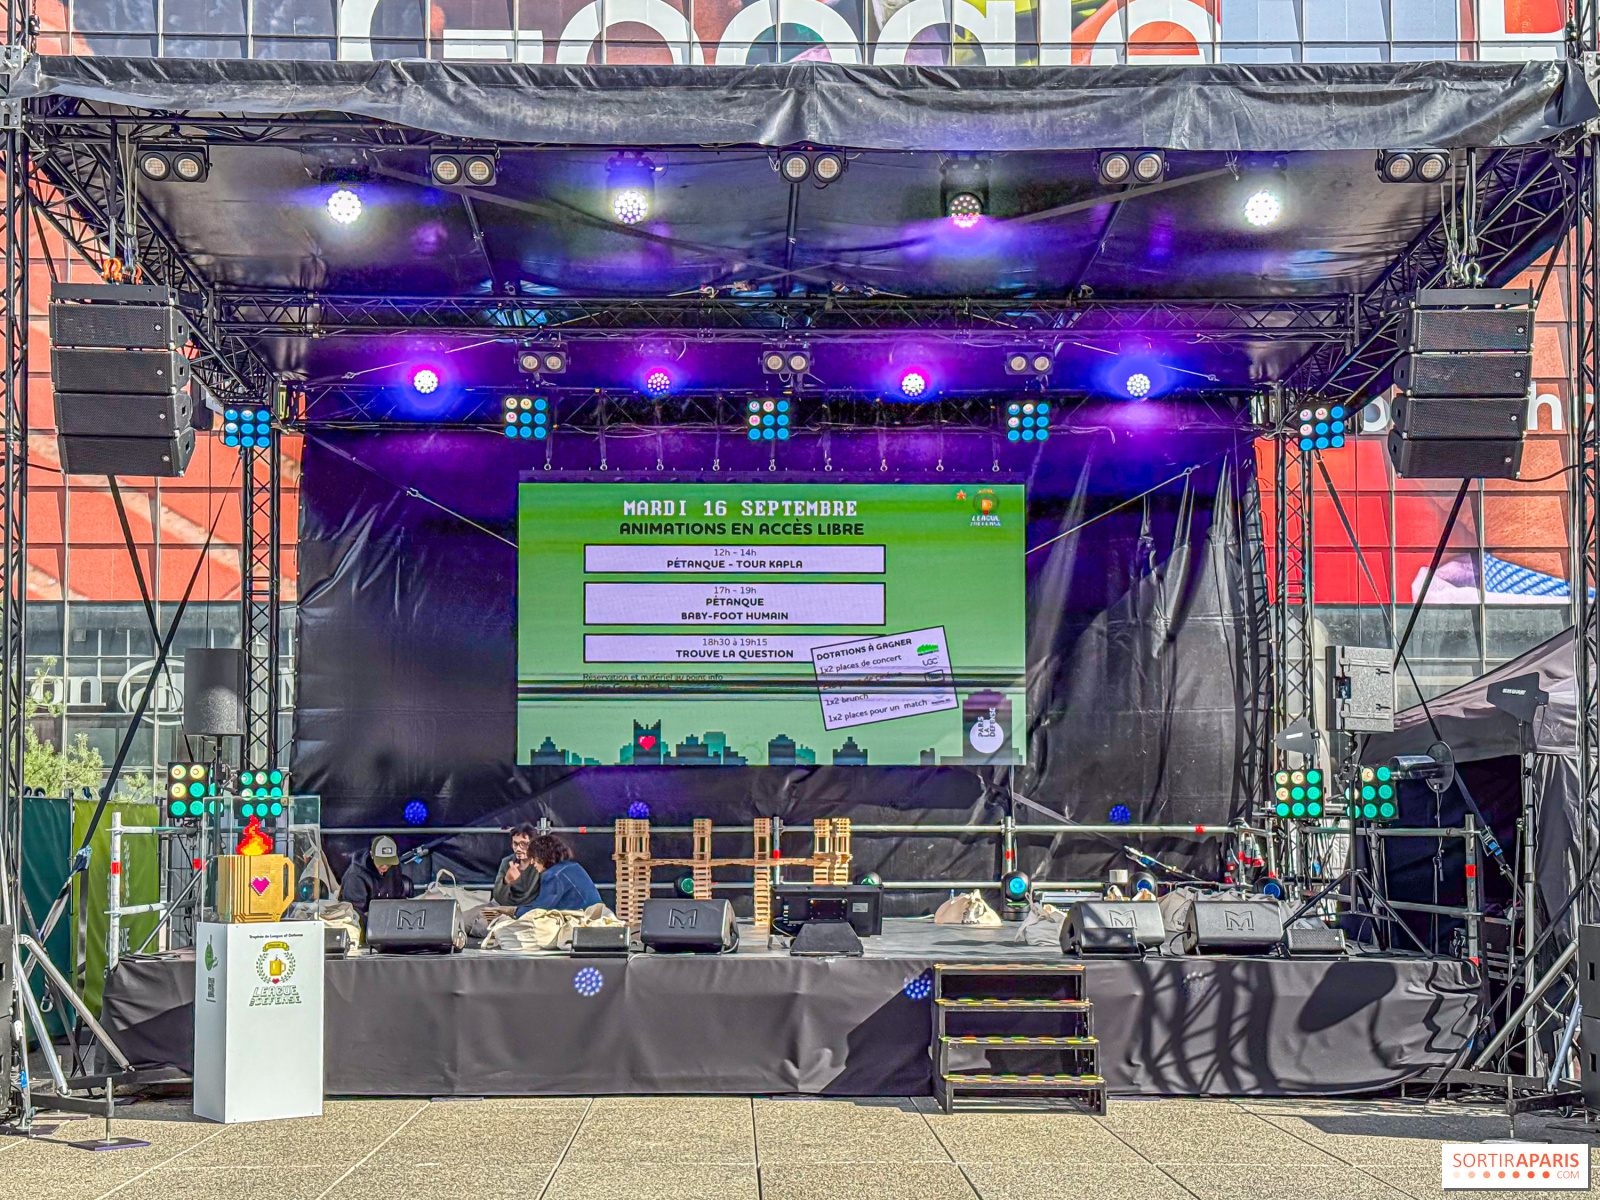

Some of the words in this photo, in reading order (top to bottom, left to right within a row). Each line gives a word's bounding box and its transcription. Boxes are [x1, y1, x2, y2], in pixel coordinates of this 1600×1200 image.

[623, 500, 687, 516] MARDI
[703, 500, 727, 516] 16
[741, 500, 858, 517] SEPTEMBRE
[619, 522, 727, 536] ANIMATIONS
[731, 522, 754, 536] EN
[758, 517, 813, 536] ACCÈS
[817, 522, 865, 536] LIBRE
[713, 548, 731, 557] 12h
[739, 548, 757, 557] 14h
[666, 557, 726, 570] PÉTANQUE
[736, 560, 767, 569] TOUR
[768, 560, 804, 569] KAPLA
[713, 586, 731, 595] 17h
[739, 586, 757, 595] 19h
[705, 595, 765, 608] PÉTANQUE
[681, 611, 744, 620] BABY-FOOT
[746, 611, 789, 620] HUMAIN
[702, 638, 731, 646] 18h30
[732, 637, 738, 646] à
[739, 638, 768, 646] 19h15
[675, 649, 720, 658] TROUVE
[722, 649, 736, 658] LA
[738, 649, 794, 660] QUESTION
[816, 645, 867, 661] DOTATIONS
[868, 642, 875, 652] À
[876, 638, 912, 651] GAGNER
[819, 665, 833, 675] 1x2
[835, 661, 860, 673] places
[861, 659, 871, 667] de
[872, 654, 903, 666] concert
[841, 693, 869, 704] brunch
[828, 713, 843, 723] 1x2
[844, 709, 868, 721] places
[869, 706, 888, 717] pour
[889, 704, 900, 712] un
[903, 698, 928, 710] match
[253, 985, 299, 997] LEAGUE
